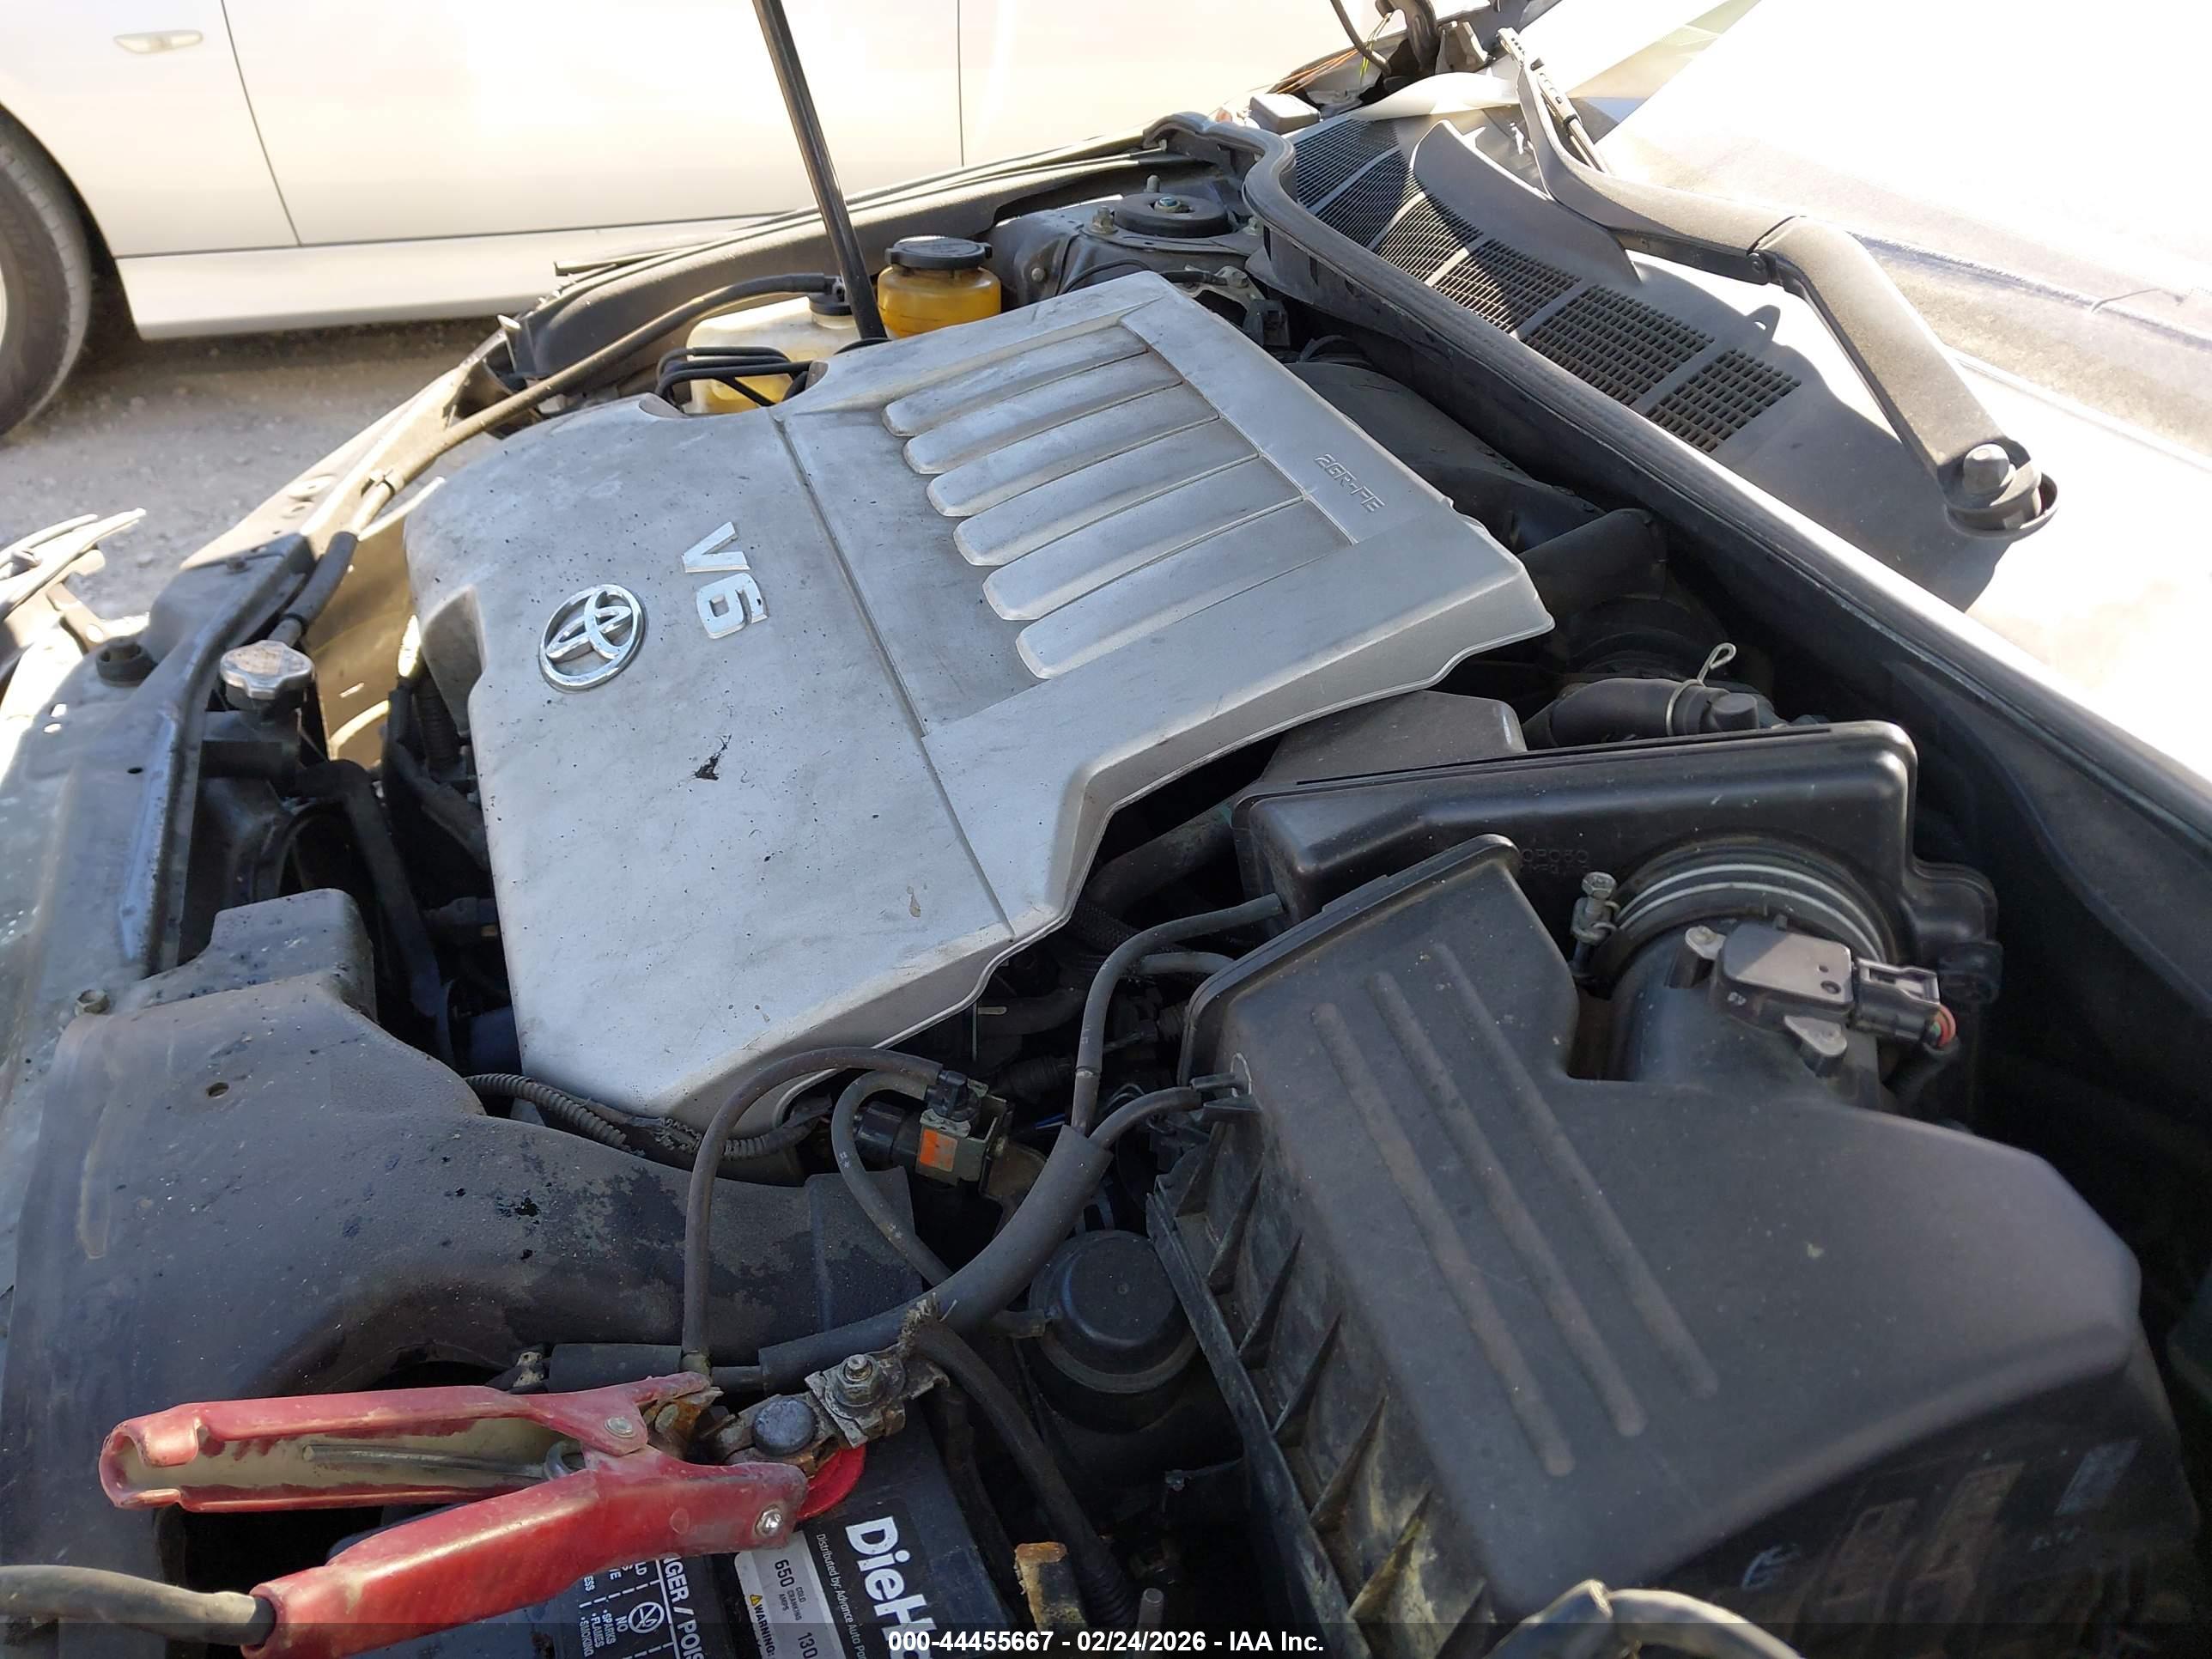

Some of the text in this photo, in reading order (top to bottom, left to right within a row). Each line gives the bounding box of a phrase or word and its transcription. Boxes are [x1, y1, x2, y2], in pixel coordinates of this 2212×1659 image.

[1314, 453, 1386, 513] 2GR-FE
[681, 521, 769, 640] V6
[775, 1559, 795, 1588] 650
[817, 1533, 840, 1577] Distributed
[830, 1577, 842, 1590] by:
[836, 1590, 854, 1624] Advance
[847, 1623, 861, 1644] Auto
[779, 1593, 789, 1612] AMPS
[787, 1589, 802, 1621] CRANKING
[795, 1586, 807, 1603] COLD
[615, 1615, 629, 1632] NO
[672, 1606, 695, 1615] /
[754, 1603, 776, 1657] WARNING:
